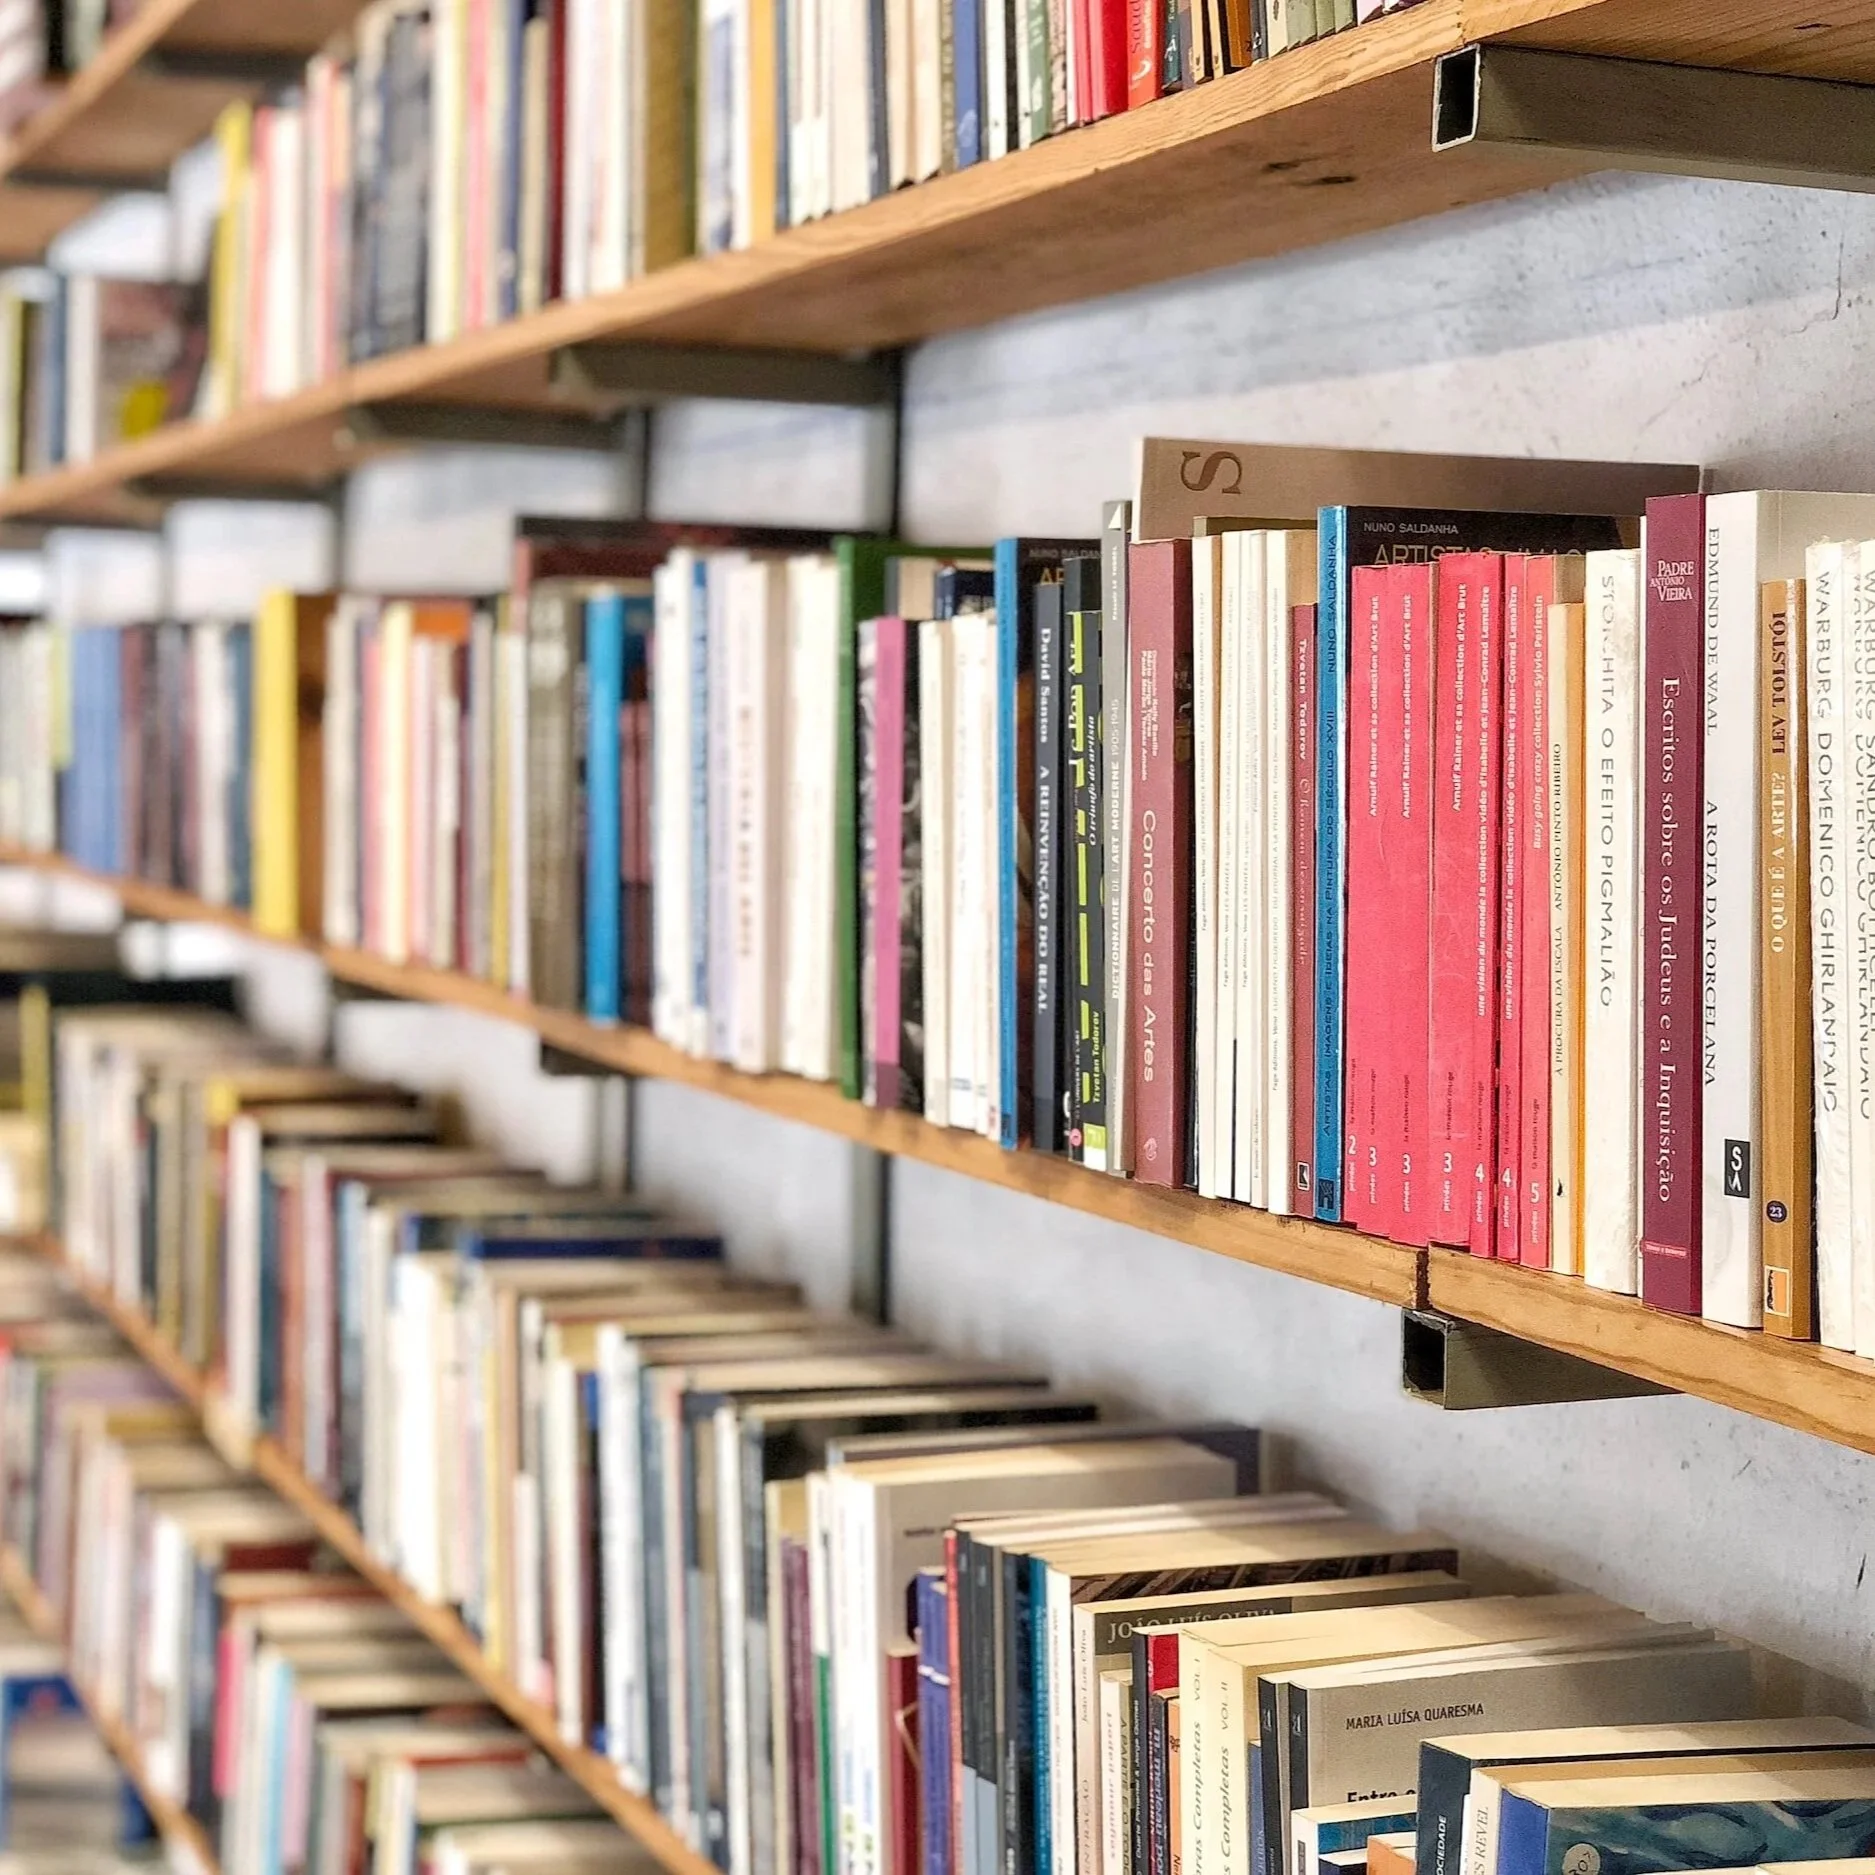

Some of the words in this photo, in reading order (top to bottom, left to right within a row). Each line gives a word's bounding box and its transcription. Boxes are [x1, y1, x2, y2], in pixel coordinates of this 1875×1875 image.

[1364, 523, 1395, 534] NUNO
[1399, 523, 1459, 535] SALDANHA
[1327, 535, 1337, 622] SALDANHA
[1650, 576, 1684, 587] ANTÓNIO
[1657, 560, 1694, 576] PADRE
[1708, 528, 1720, 628] EDMUND
[1370, 596, 1378, 622] Brut
[1403, 594, 1411, 620] Brut
[1458, 584, 1466, 609] Brut
[1657, 585, 1693, 601] VIEIRA
[1457, 612, 1466, 641] d'Art
[1480, 586, 1490, 638] Lemaître
[1507, 586, 1518, 638] Lemaître
[1534, 595, 1544, 648] Perlstein
[1041, 629, 1051, 680] David
[1327, 630, 1336, 673] NUNO
[1370, 622, 1378, 652] d'Art
[1403, 622, 1411, 651] d'Art
[1707, 636, 1719, 664] DE
[1816, 572, 1832, 718] WARBURG
[1456, 644, 1466, 701] collection
[1480, 641, 1490, 714] Jean-Conrad
[1508, 641, 1517, 714] Jean-Conrad
[1534, 650, 1544, 686] Sylvio
[1768, 612, 1786, 708] TOLSTÓI
[1370, 655, 1378, 710] collection
[1403, 654, 1411, 710] collection
[1041, 687, 1051, 743] Santos
[1533, 688, 1543, 748] collection
[1706, 672, 1718, 736] WAAL
[1087, 716, 1095, 758] artista
[1111, 699, 1119, 755] 1905-1945
[1300, 701, 1308, 760] Todorov
[1326, 710, 1334, 743] XVIII
[1370, 728, 1378, 740] et
[1403, 728, 1411, 740] et
[1602, 728, 1614, 748] O
[1662, 678, 1680, 783] Escritos
[1770, 714, 1786, 754] LEV
[1370, 742, 1378, 778] Rainer
[1403, 742, 1411, 779] Rainer
[1454, 734, 1463, 770] Rainer
[1479, 732, 1488, 788] d'Isabelle
[1506, 732, 1516, 788] d'Isabelle
[1534, 752, 1544, 783] crazy
[1553, 743, 1561, 796] RIBEIRO
[1040, 766, 1049, 780] A
[1088, 765, 1096, 780] do
[1324, 750, 1334, 808] SÉCULO
[1088, 784, 1097, 830] triunfo
[1111, 762, 1119, 830] MODERNE
[1370, 781, 1378, 816] Arnulf
[1403, 782, 1411, 818] Arnulf
[1452, 774, 1462, 811] Arnulf
[1479, 790, 1488, 823] vidéo
[1506, 792, 1515, 824] vidéo
[1534, 786, 1544, 818] going
[1602, 758, 1614, 844] EFEITO
[1706, 800, 1718, 815] A
[1771, 772, 1784, 840] ARTE?
[1326, 815, 1333, 834] DO
[1553, 801, 1562, 842] PINTO
[1661, 792, 1679, 866] sobre
[1818, 733, 1834, 898] DOMENICO
[1037, 786, 1050, 920] REINVENÇÃO
[1089, 833, 1096, 846] O
[1111, 835, 1119, 872] L'ART
[1533, 822, 1543, 848] Busy
[1771, 846, 1784, 860] A
[1324, 842, 1333, 900] PINTURA
[1478, 826, 1488, 883] collection
[1505, 826, 1515, 885] collection
[1706, 824, 1717, 888] ROTA
[1768, 866, 1784, 880] É
[1112, 880, 1120, 892] DE
[1144, 810, 1156, 943] Concerto
[1552, 847, 1562, 910] ANTÓNIO
[1661, 876, 1674, 905] os
[1324, 907, 1333, 924] NA
[1478, 898, 1487, 938] monde
[1505, 902, 1514, 941] monde
[1706, 896, 1716, 930] DA
[1770, 886, 1787, 930] QUE
[1038, 925, 1048, 958] DO
[1112, 898, 1120, 998] DICTIONNAIRE
[1478, 940, 1487, 956] du
[1554, 926, 1562, 974] ESCALA
[1600, 856, 1615, 1007] PIGMALIÃO
[1770, 936, 1784, 953] O
[1324, 930, 1333, 974] IDEIAS
[1504, 943, 1514, 958] du
[1659, 910, 1678, 1006] Judeus
[1038, 964, 1048, 1015] REAL
[1144, 952, 1156, 996] das
[1478, 958, 1487, 992] vision
[1504, 961, 1513, 996] vision
[1554, 978, 1562, 996] DA
[1478, 994, 1486, 1016] une
[1505, 998, 1513, 1020] une
[1660, 1014, 1672, 1030] e
[1705, 938, 1716, 1086] PORCELANA
[1092, 1012, 1100, 1056] Todorov
[1144, 1005, 1156, 1082] Artes
[1323, 997, 1332, 1058] IMAGENS
[1554, 1001, 1562, 1064] PROCURA
[1660, 1038, 1672, 1053] a
[1092, 1058, 1100, 1103] Tzvetan
[1348, 1136, 1356, 1154] 2
[1656, 1062, 1676, 1202] Inquisição
[1368, 1146, 1376, 1167] 3
[1402, 1154, 1412, 1175] 3
[1442, 1152, 1452, 1174] 3
[1475, 1163, 1484, 1182] 4
[1502, 1168, 1512, 1188] 4
[1531, 1182, 1539, 1204] 5
[1770, 1206, 1783, 1218] 23
[1221, 1682, 1228, 1690] II
[1346, 1714, 1383, 1730] MARIA
[1387, 1709, 1420, 1725] LUÍSA
[1424, 1703, 1483, 1722] QUARESMA
[1121, 1734, 1129, 1791] PARTE
[1134, 1737, 1142, 1767] Jorge
[1193, 1721, 1204, 1830] Completas
[1121, 1796, 1129, 1804] E
[1121, 1811, 1129, 1824] O
[1220, 1746, 1232, 1858] Completas
[1473, 1806, 1489, 1858] REVEL
